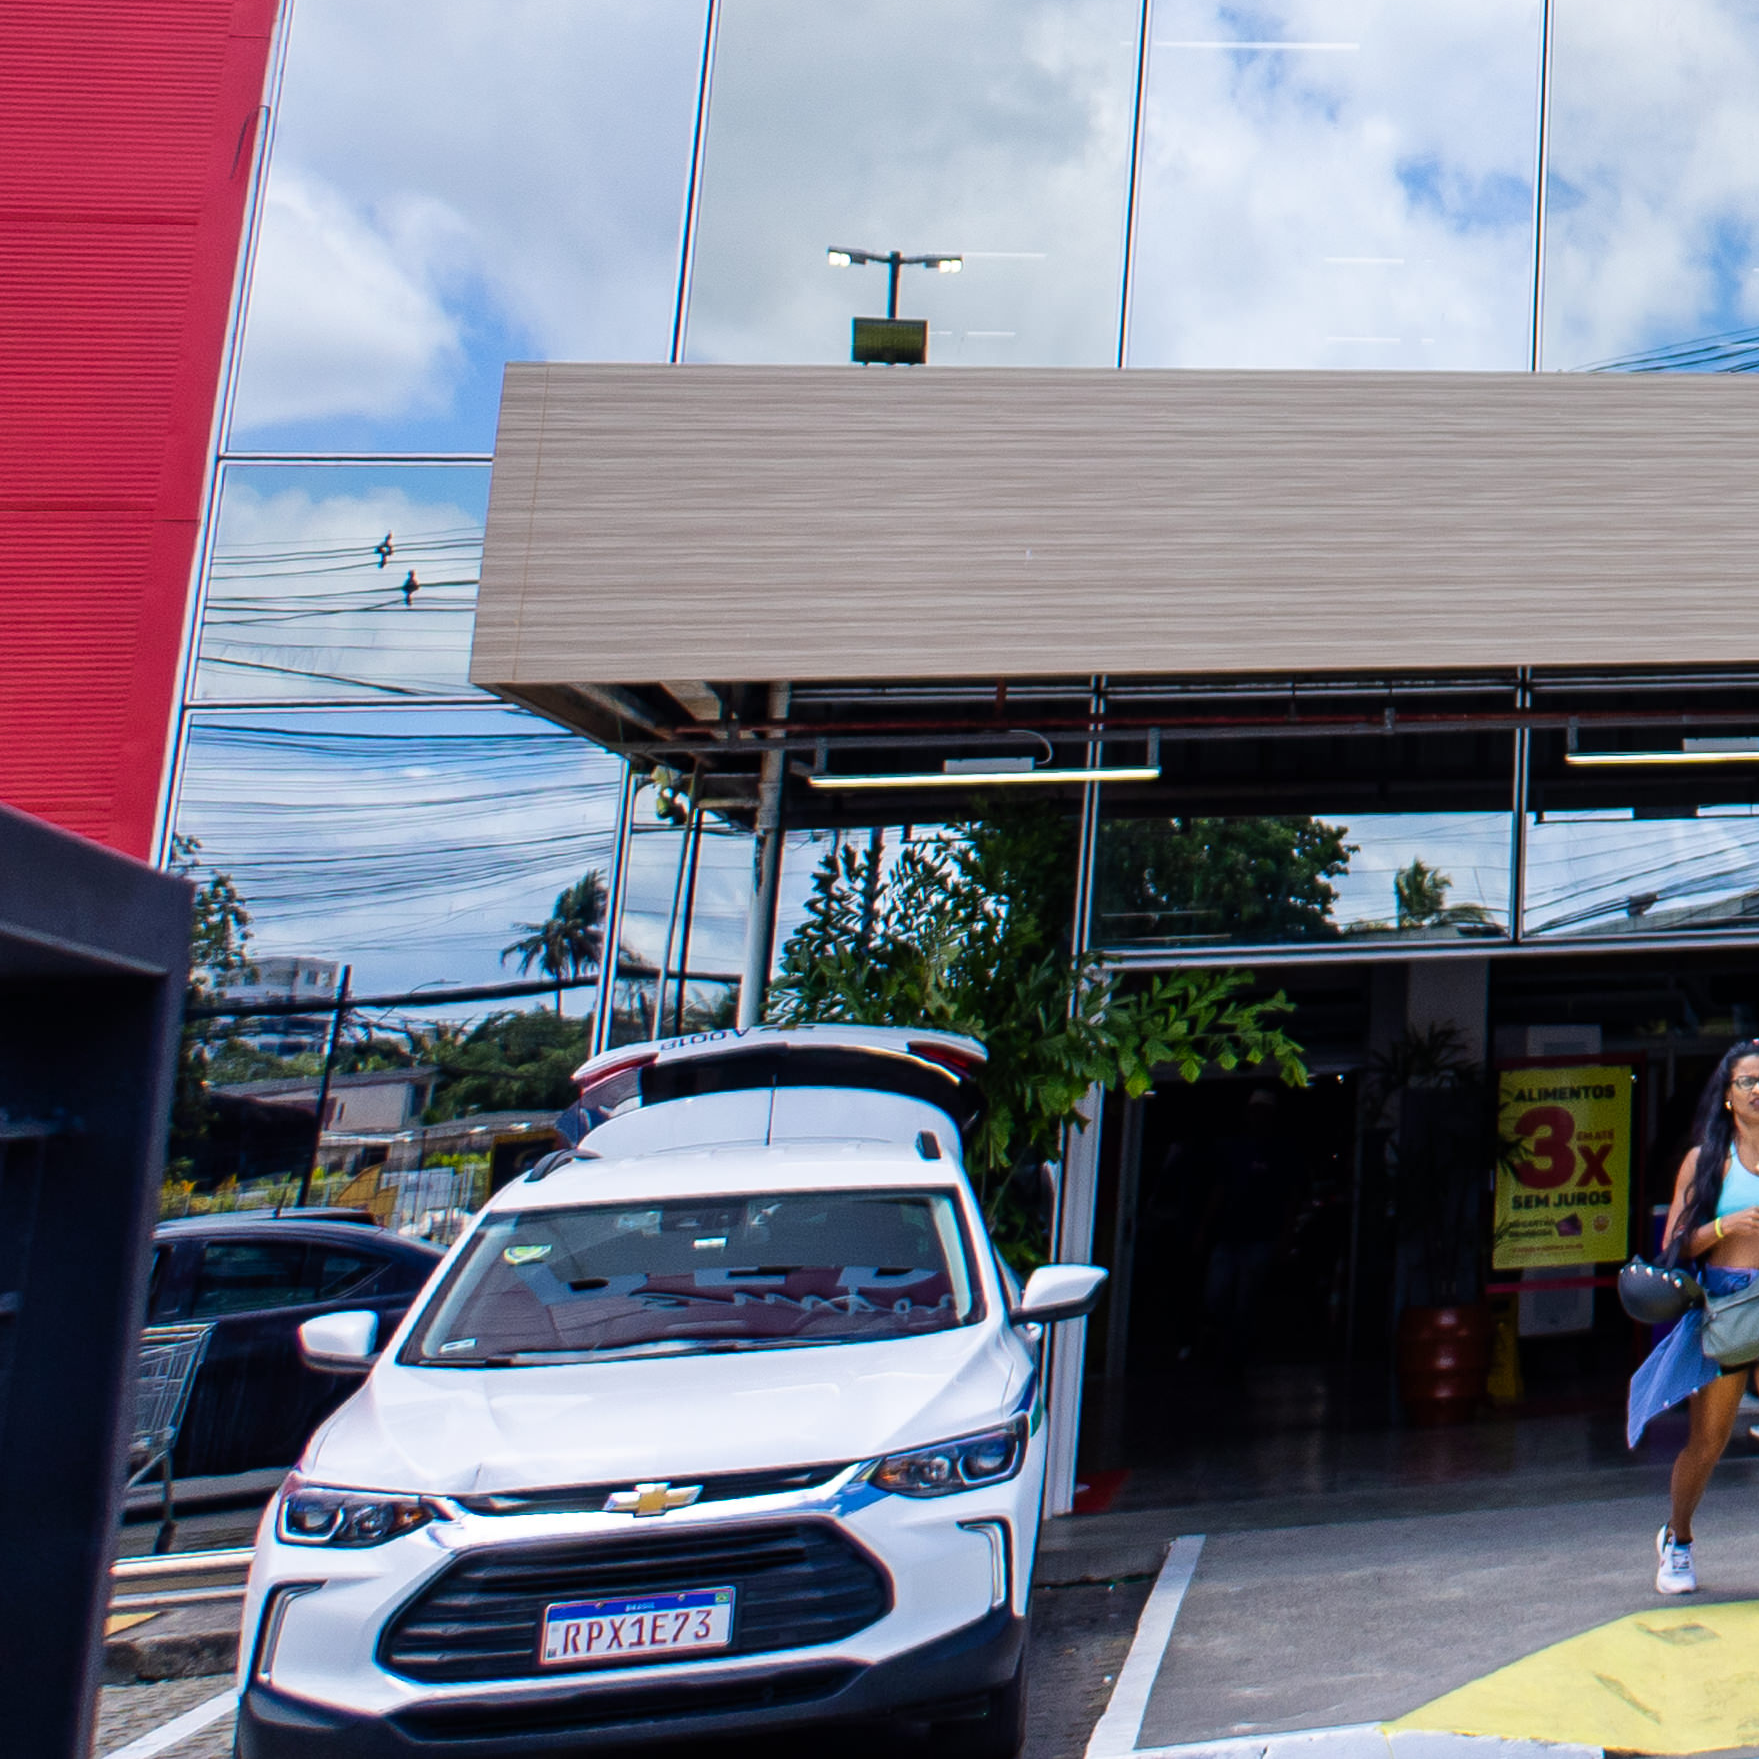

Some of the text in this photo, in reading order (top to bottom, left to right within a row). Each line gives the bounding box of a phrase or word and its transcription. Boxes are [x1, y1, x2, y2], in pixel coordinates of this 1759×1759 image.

[1514, 1084, 1616, 1103] ALIMENTOS
[1511, 1191, 1612, 1209] SEM JUROS
[563, 1608, 714, 1655] RPX1E73
